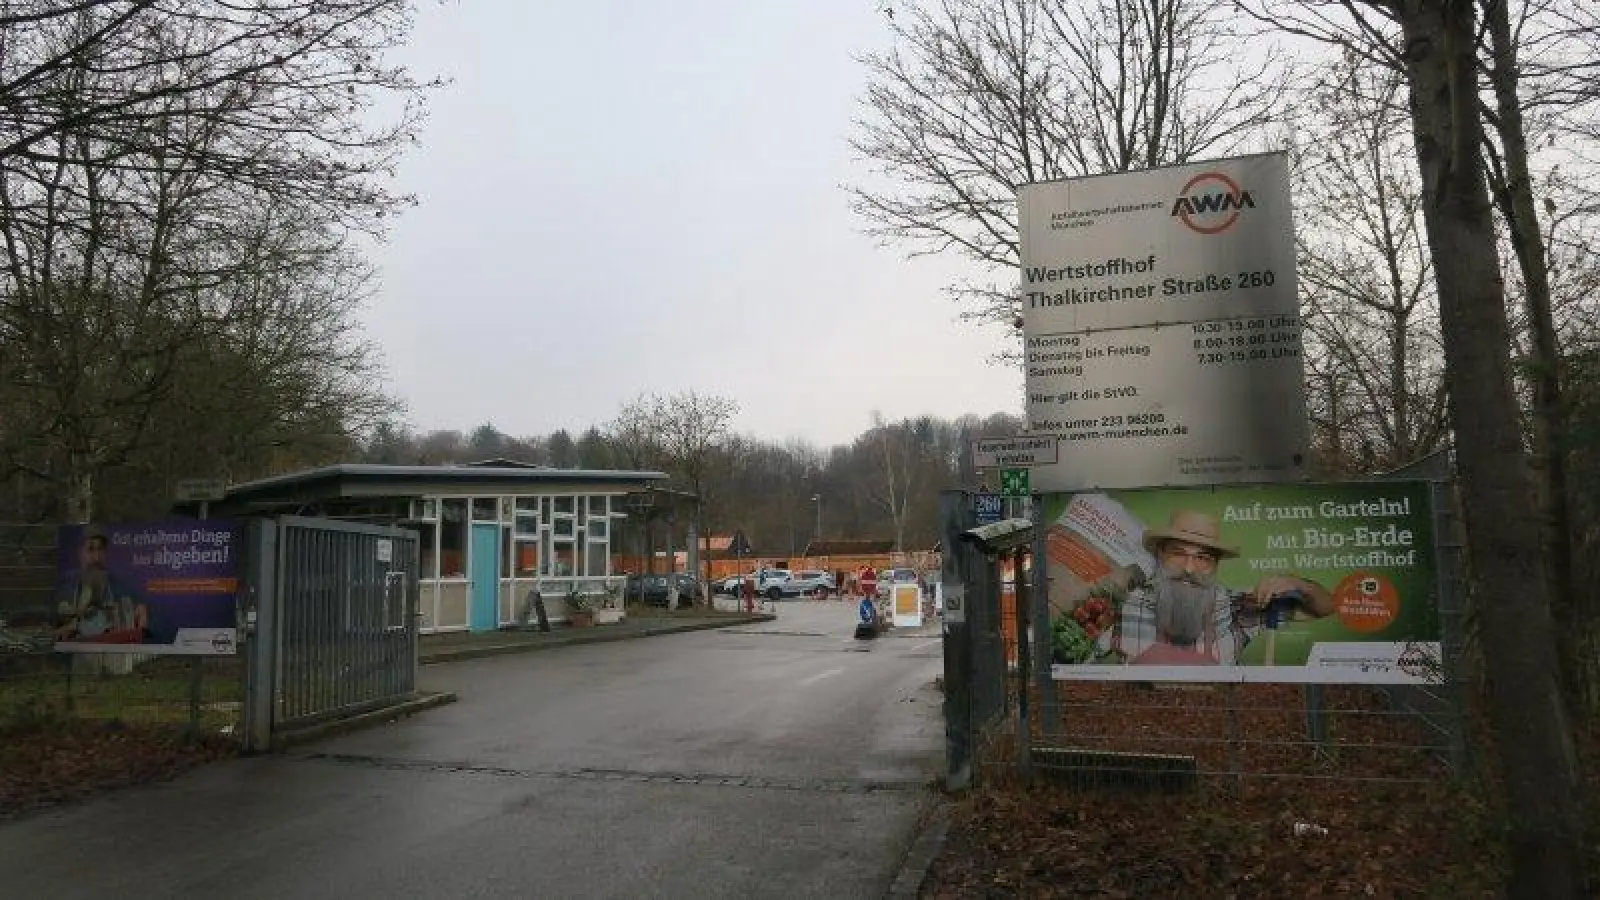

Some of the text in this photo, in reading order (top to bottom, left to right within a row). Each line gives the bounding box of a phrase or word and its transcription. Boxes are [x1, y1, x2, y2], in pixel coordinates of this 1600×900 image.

[1171, 191, 1256, 216] AWM
[1026, 256, 1156, 284] Wertstoffhof
[1026, 270, 1275, 309] Thalkirchner Straße 260
[1028, 337, 1080, 348] Montag
[1029, 351, 1082, 363] Dienstag
[1085, 347, 1104, 359] bis
[1106, 345, 1151, 357] Freitag
[1029, 366, 1082, 377] Samstag
[1081, 389, 1101, 401] die
[1065, 418, 1098, 429] unter
[1224, 497, 1411, 521] Auf zum Garteln!
[191, 528, 231, 546] Dinge
[1267, 524, 1414, 549] Mit Bio-Erde
[153, 546, 229, 570] abgeben!
[1250, 550, 1417, 569] vom Wertstoffhof
